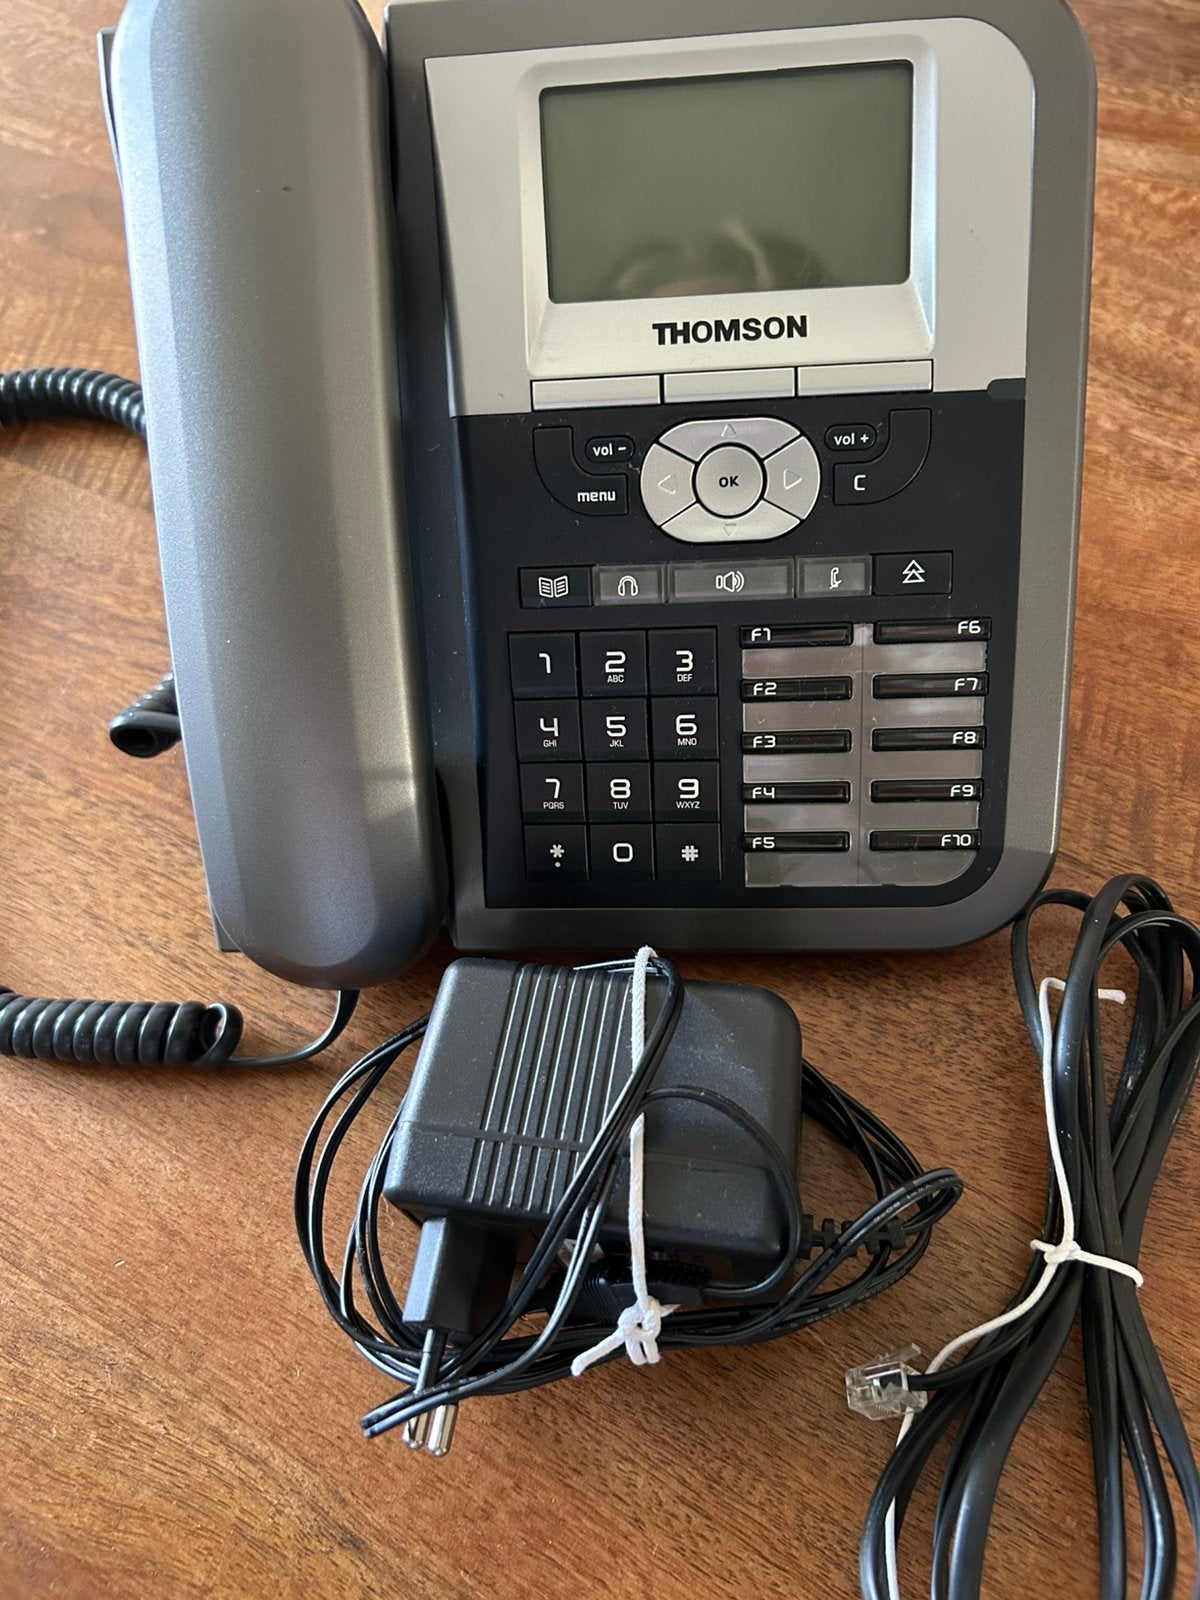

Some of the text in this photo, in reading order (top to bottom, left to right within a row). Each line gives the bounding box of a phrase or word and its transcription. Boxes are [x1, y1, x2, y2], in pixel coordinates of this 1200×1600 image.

[651, 314, 808, 346] THOMSON
[833, 432, 855, 446] vol
[592, 442, 613, 457] vol
[718, 475, 740, 488] OK
[853, 474, 866, 491] C
[577, 490, 616, 503] menu
[751, 627, 771, 642] F1
[957, 620, 982, 635] F6
[538, 652, 551, 674] 1
[604, 651, 626, 673] 2
[675, 650, 694, 672] 3
[607, 674, 625, 683] ABC
[676, 673, 693, 683] DEF
[954, 677, 979, 692] F7
[753, 681, 778, 696] F2
[539, 717, 559, 737] 4
[605, 716, 627, 738] 5
[675, 714, 698, 736] 6
[542, 739, 557, 748] GHI
[609, 739, 625, 748] JKL
[677, 737, 698, 746] MNO
[752, 735, 776, 749] F3
[952, 731, 976, 745] F8
[545, 778, 561, 799] 7
[609, 778, 631, 799] 8
[677, 778, 700, 799] 9
[751, 786, 775, 800] F4
[950, 784, 974, 798] F9
[542, 801, 565, 810] PQRS
[612, 801, 629, 810] TUV
[675, 800, 700, 809] WXYZ
[752, 836, 775, 849] F5
[941, 833, 972, 847] F10
[612, 842, 634, 863] 0
